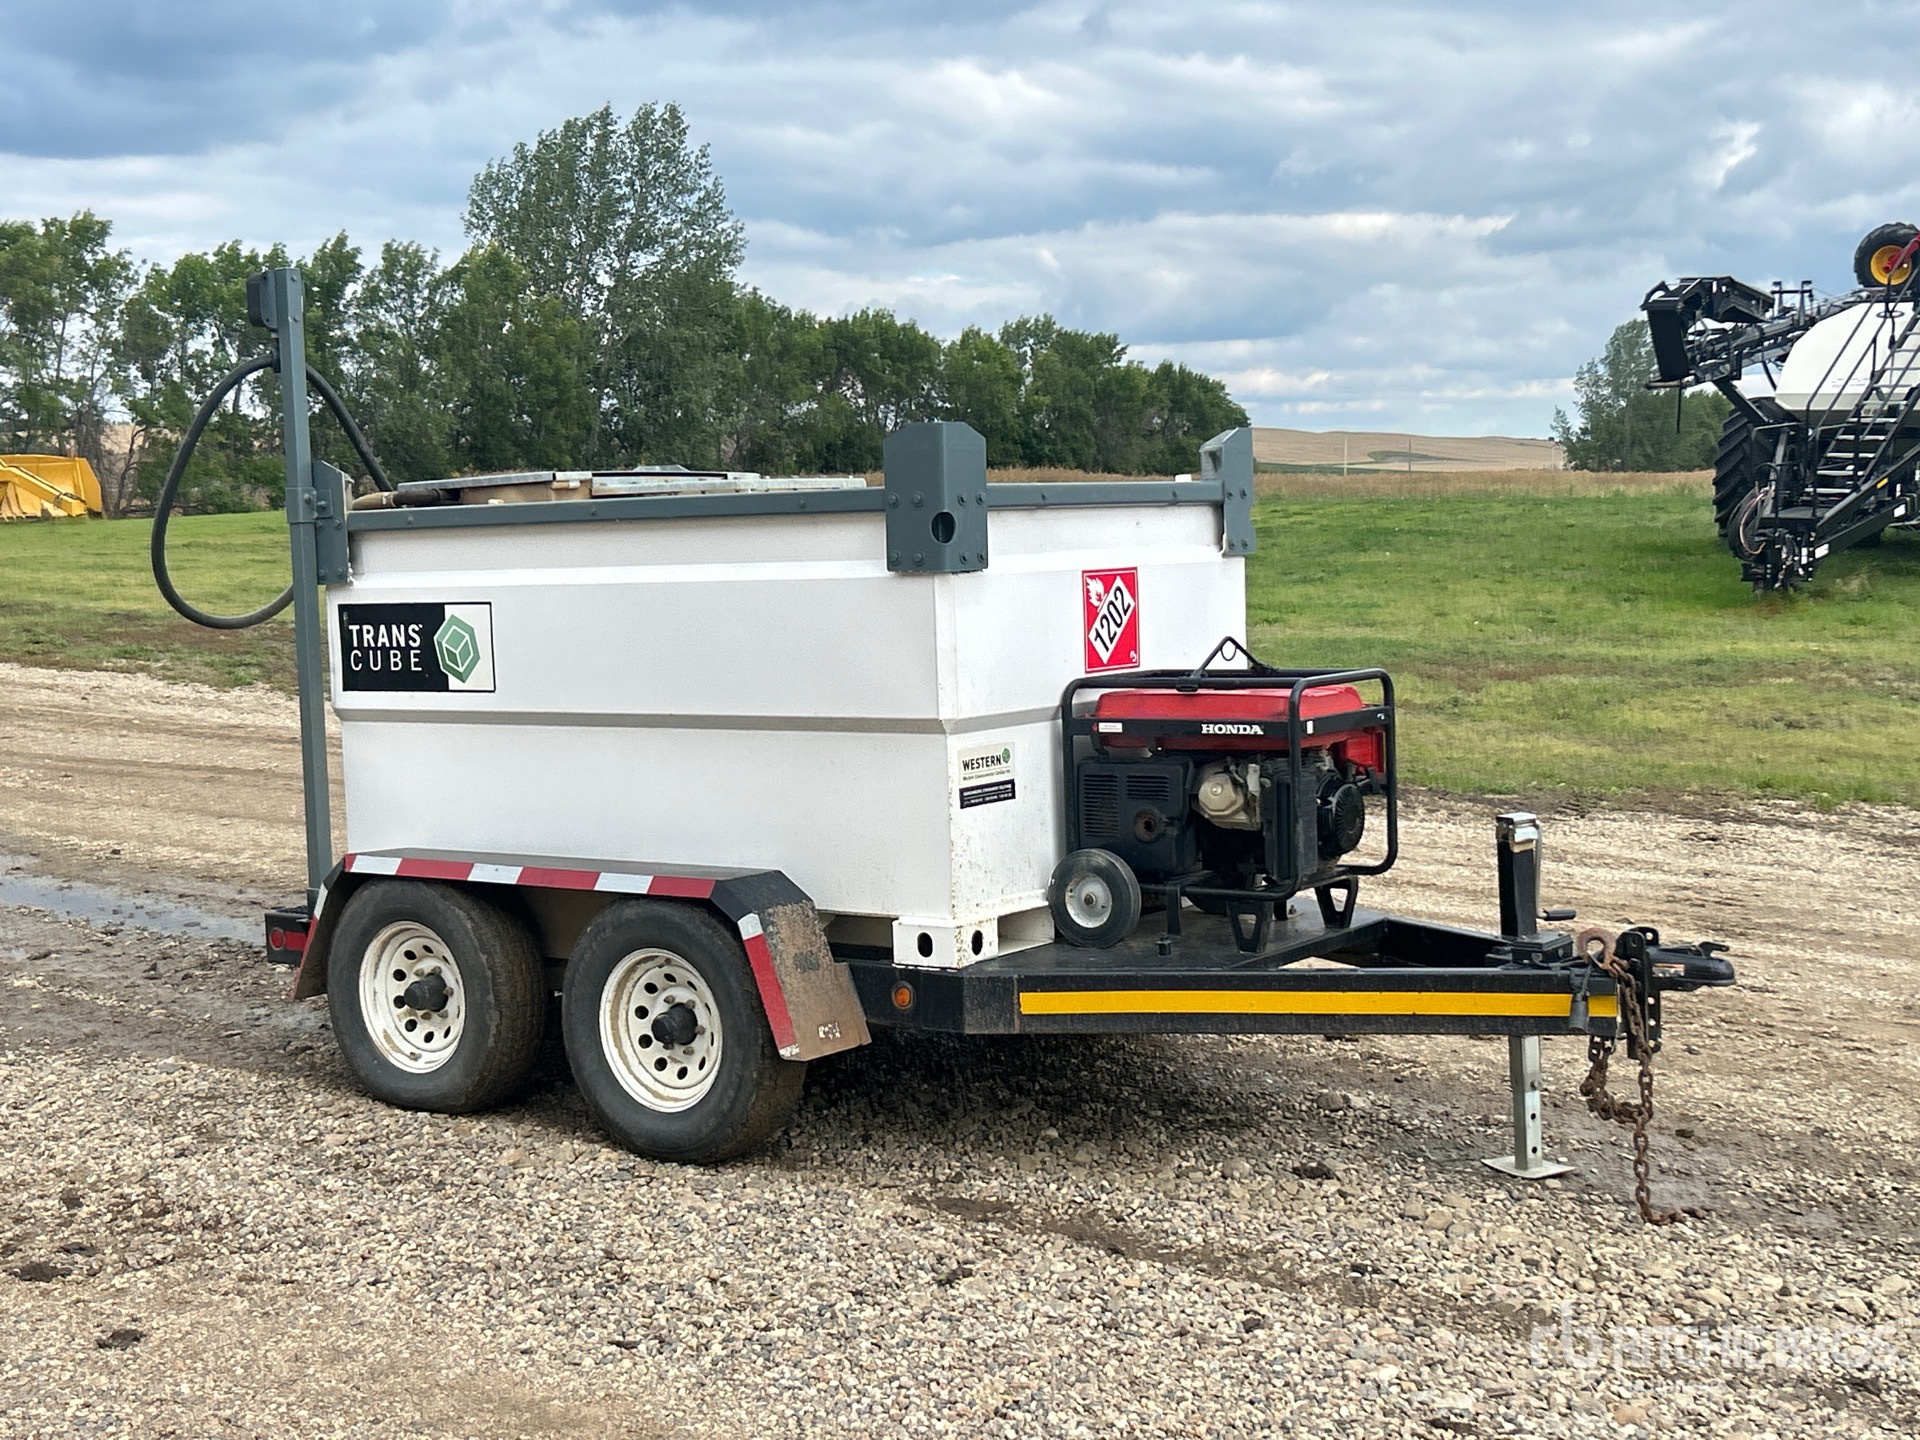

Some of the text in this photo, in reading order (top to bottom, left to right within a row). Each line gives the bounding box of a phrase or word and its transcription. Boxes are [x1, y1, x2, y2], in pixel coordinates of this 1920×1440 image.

[1094, 585, 1131, 653] 1202
[348, 623, 421, 648] TRANS
[350, 649, 423, 672] CUBE
[1201, 723, 1264, 735] HONDA
[962, 753, 1002, 772] WESTERN
